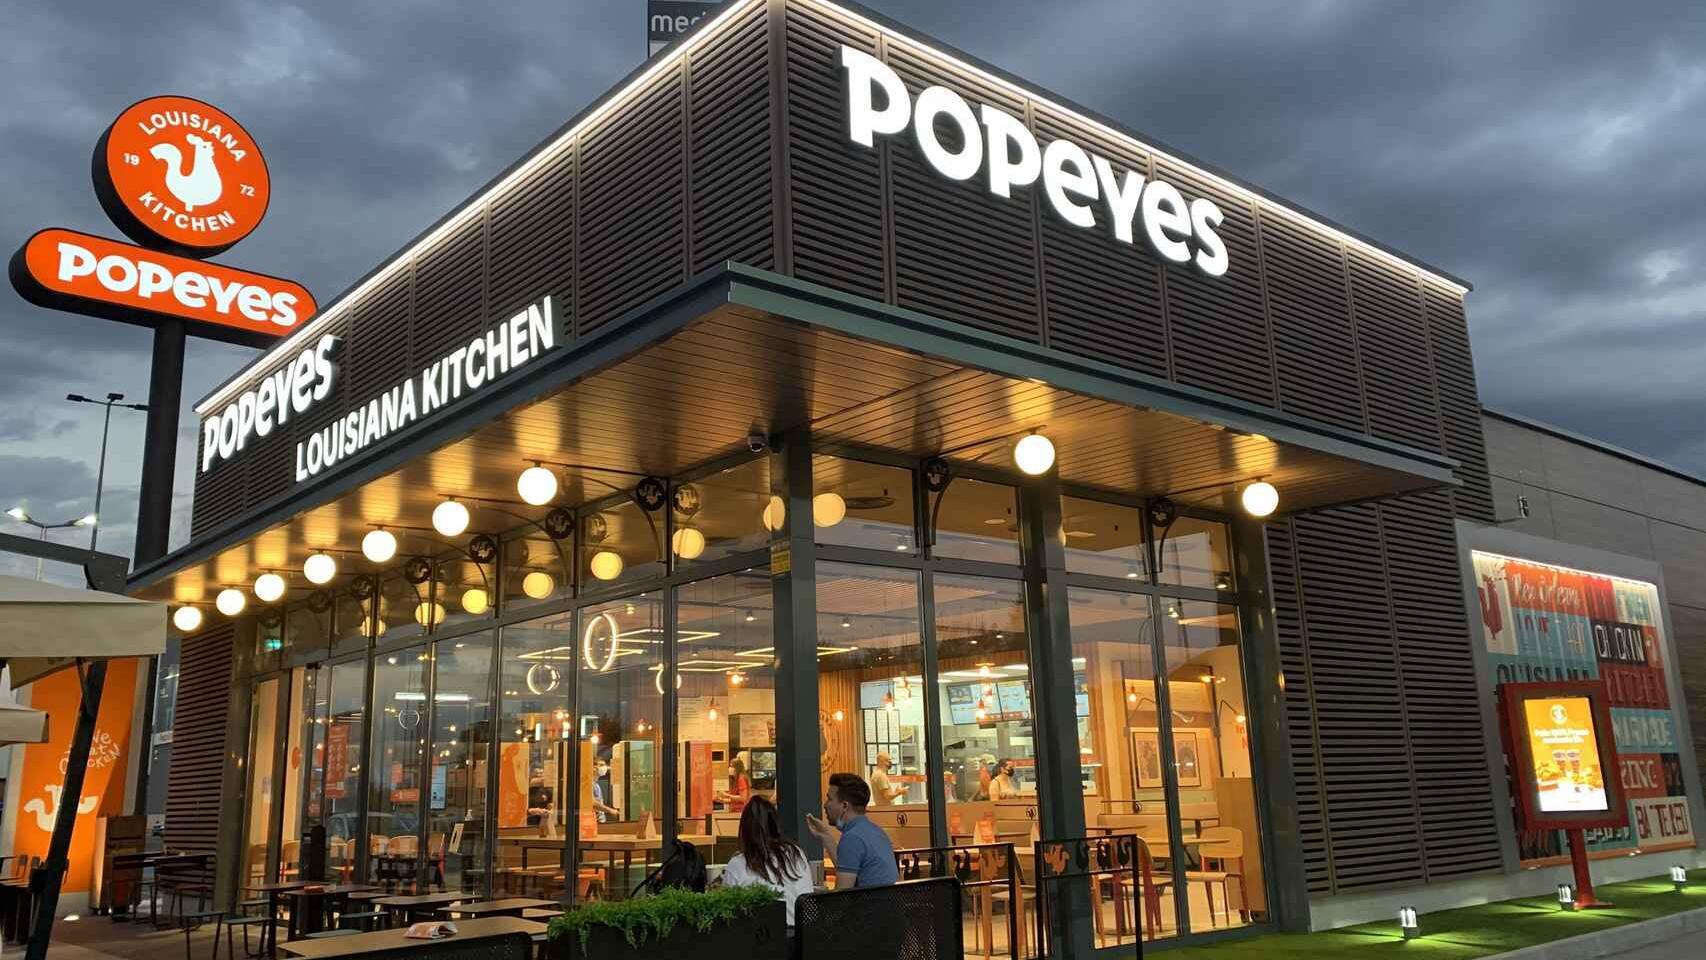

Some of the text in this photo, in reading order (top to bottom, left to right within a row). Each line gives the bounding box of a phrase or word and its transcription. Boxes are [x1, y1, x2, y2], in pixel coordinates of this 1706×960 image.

[139, 111, 247, 162] LOUISIANA
[124, 153, 140, 166] 19
[239, 184, 256, 197] 72
[138, 191, 236, 232] KITCHEN
[296, 295, 555, 482] LOUISIANA KITCHEN
